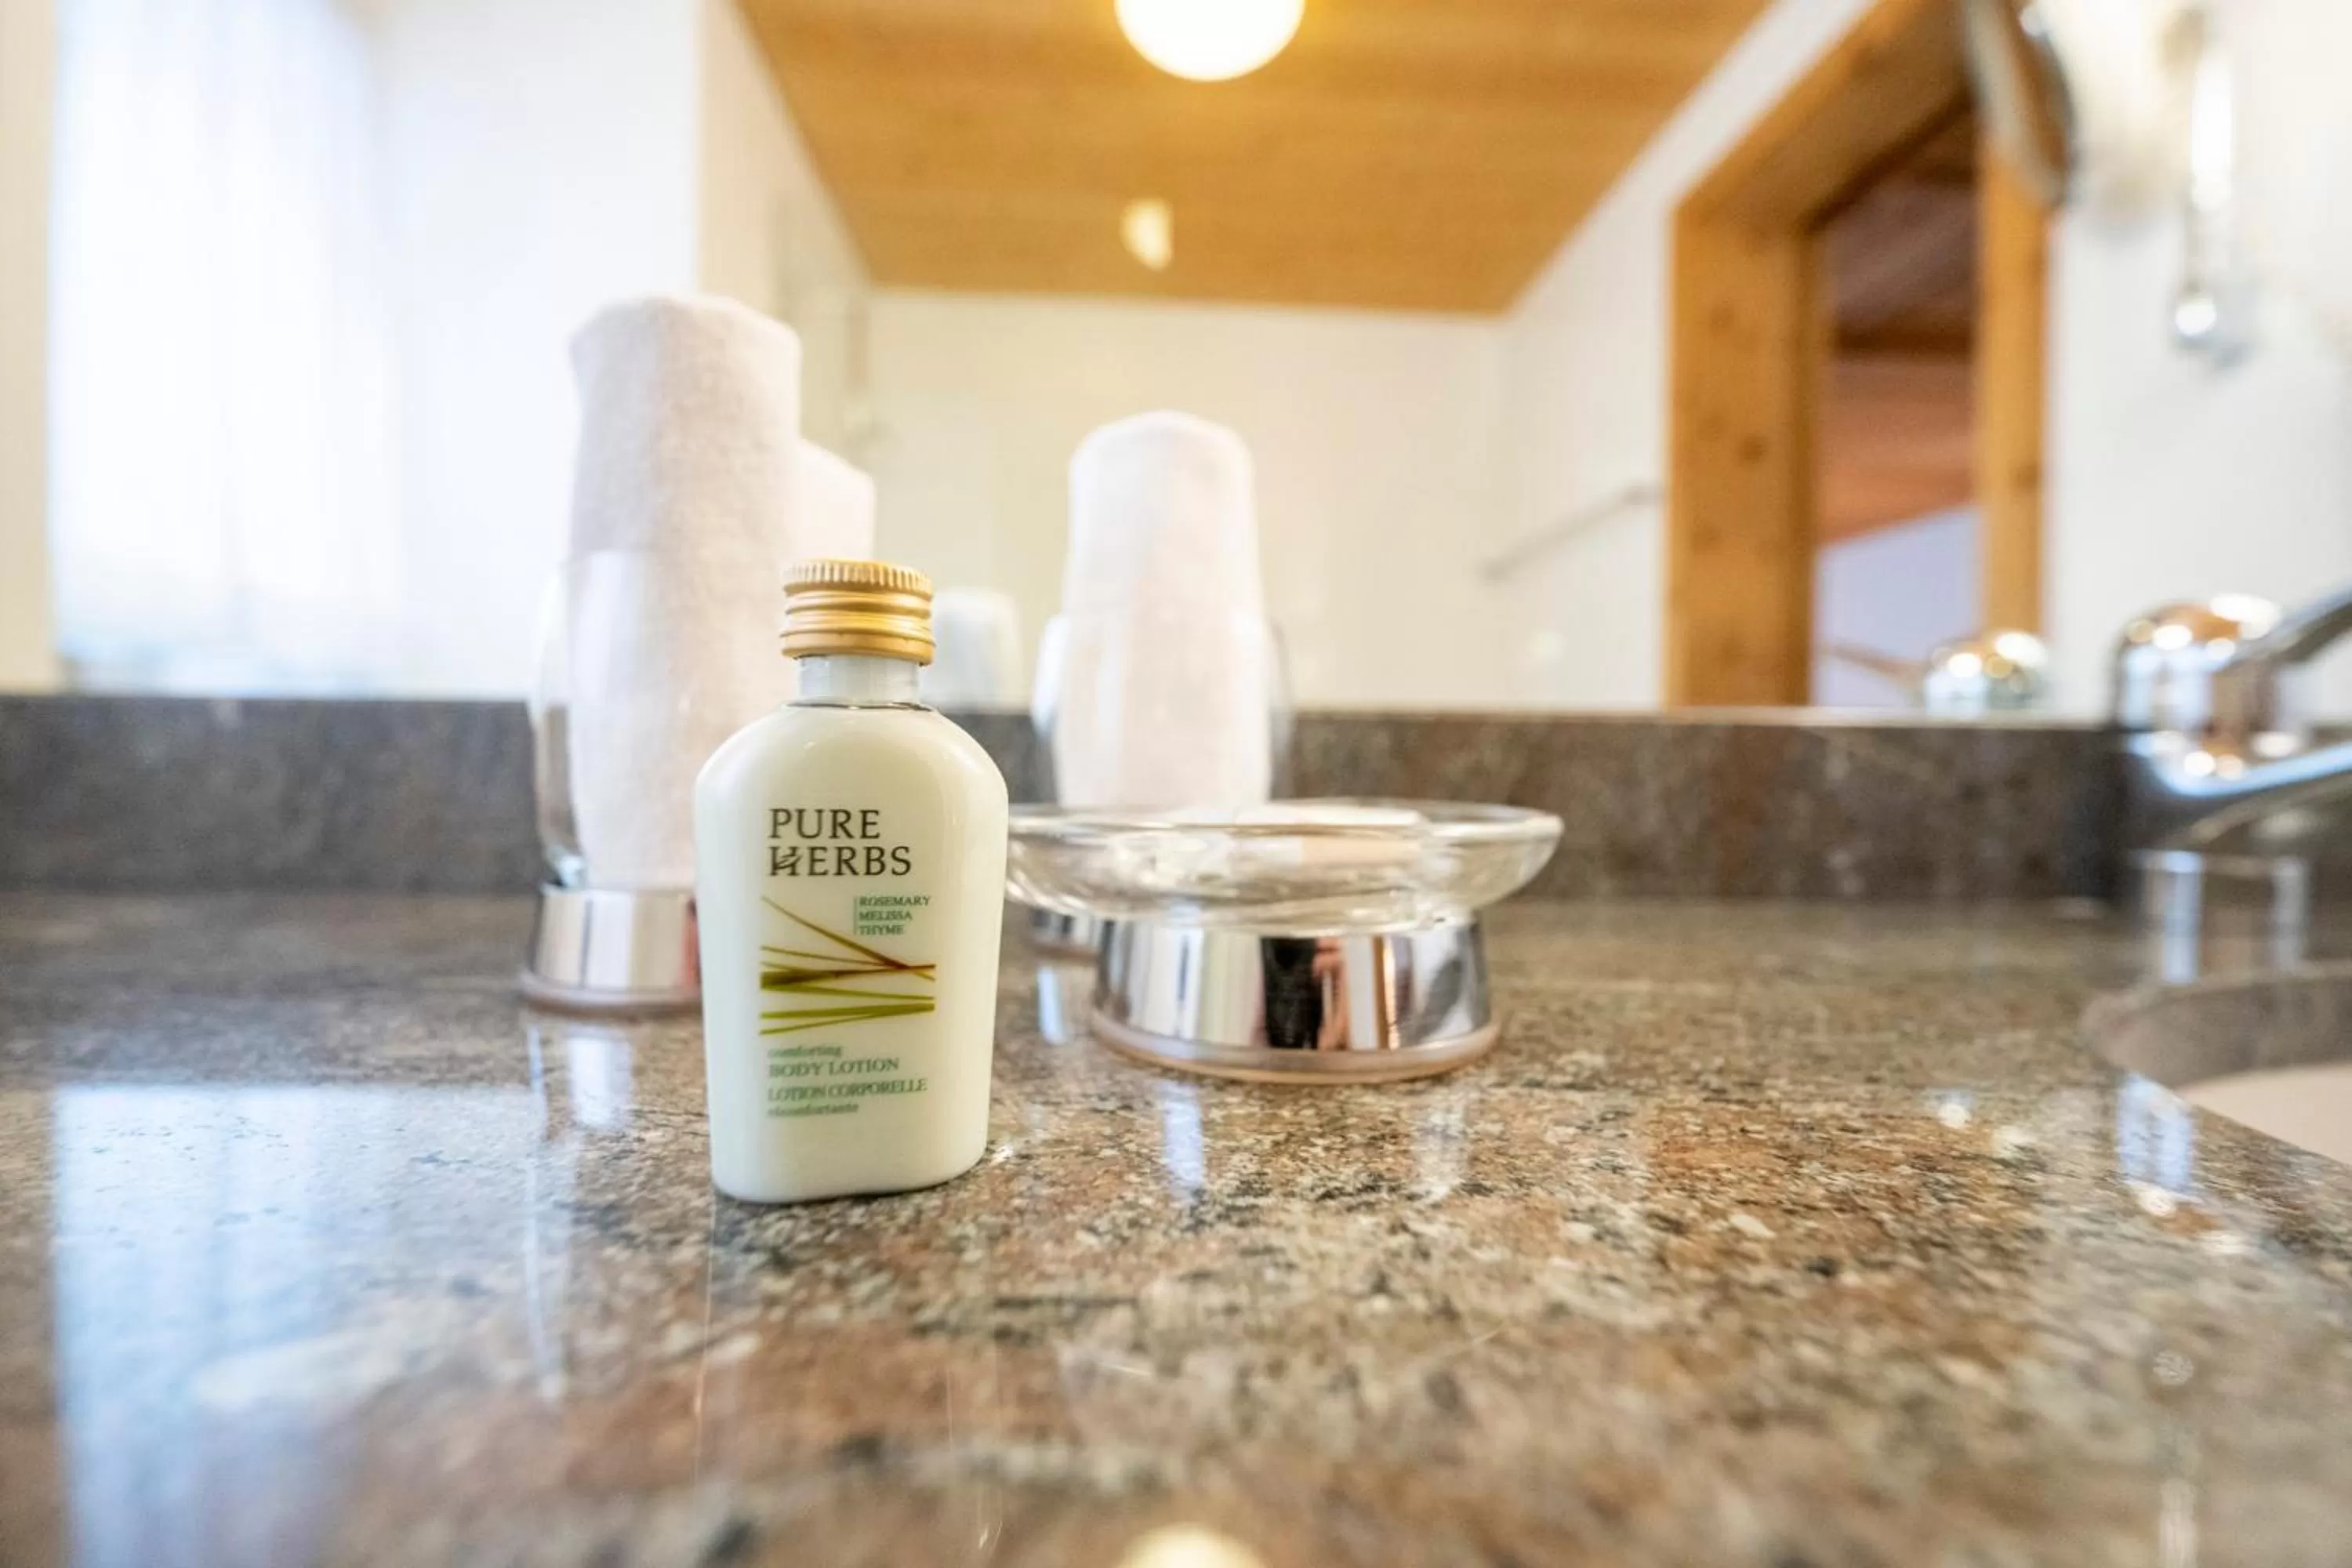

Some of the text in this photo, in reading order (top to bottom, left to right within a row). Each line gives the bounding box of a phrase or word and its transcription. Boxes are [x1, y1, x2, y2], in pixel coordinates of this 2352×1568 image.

[768, 808, 880, 840] PURE
[768, 845, 912, 877] HERBS
[858, 895, 931, 906] ROSEMARY
[858, 911, 913, 921] MELISSA
[858, 925, 905, 935] THYME
[768, 1057, 900, 1078] BODY LOTION
[768, 1077, 929, 1102] LOTION CORPORELLE
